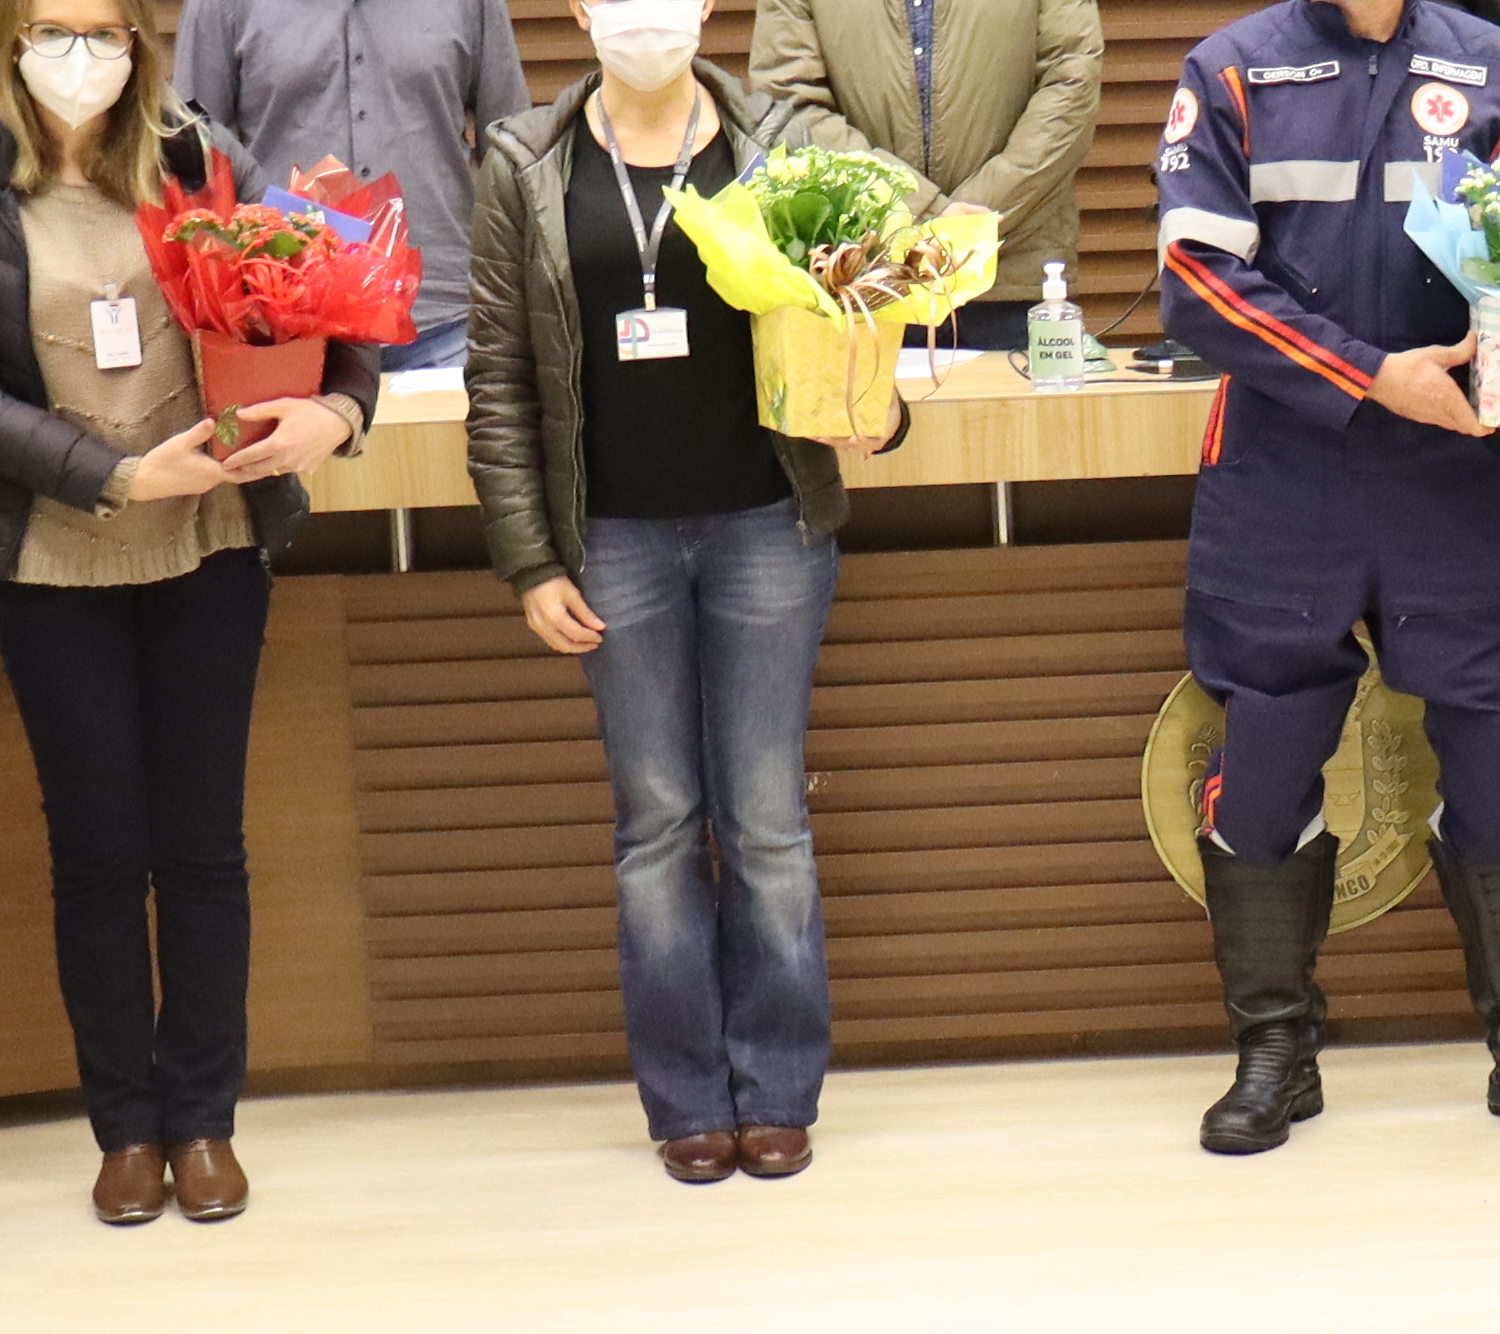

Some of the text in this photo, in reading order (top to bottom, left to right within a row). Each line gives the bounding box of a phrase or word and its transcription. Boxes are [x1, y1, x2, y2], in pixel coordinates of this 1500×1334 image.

[1423, 134, 1460, 148] SAMU
[1160, 152, 1191, 173] 192
[1423, 146, 1458, 164] 19
[1037, 336, 1075, 347] ÁLCOOL
[1039, 351, 1074, 360] EM GEL
[1335, 875, 1370, 900] NCO
